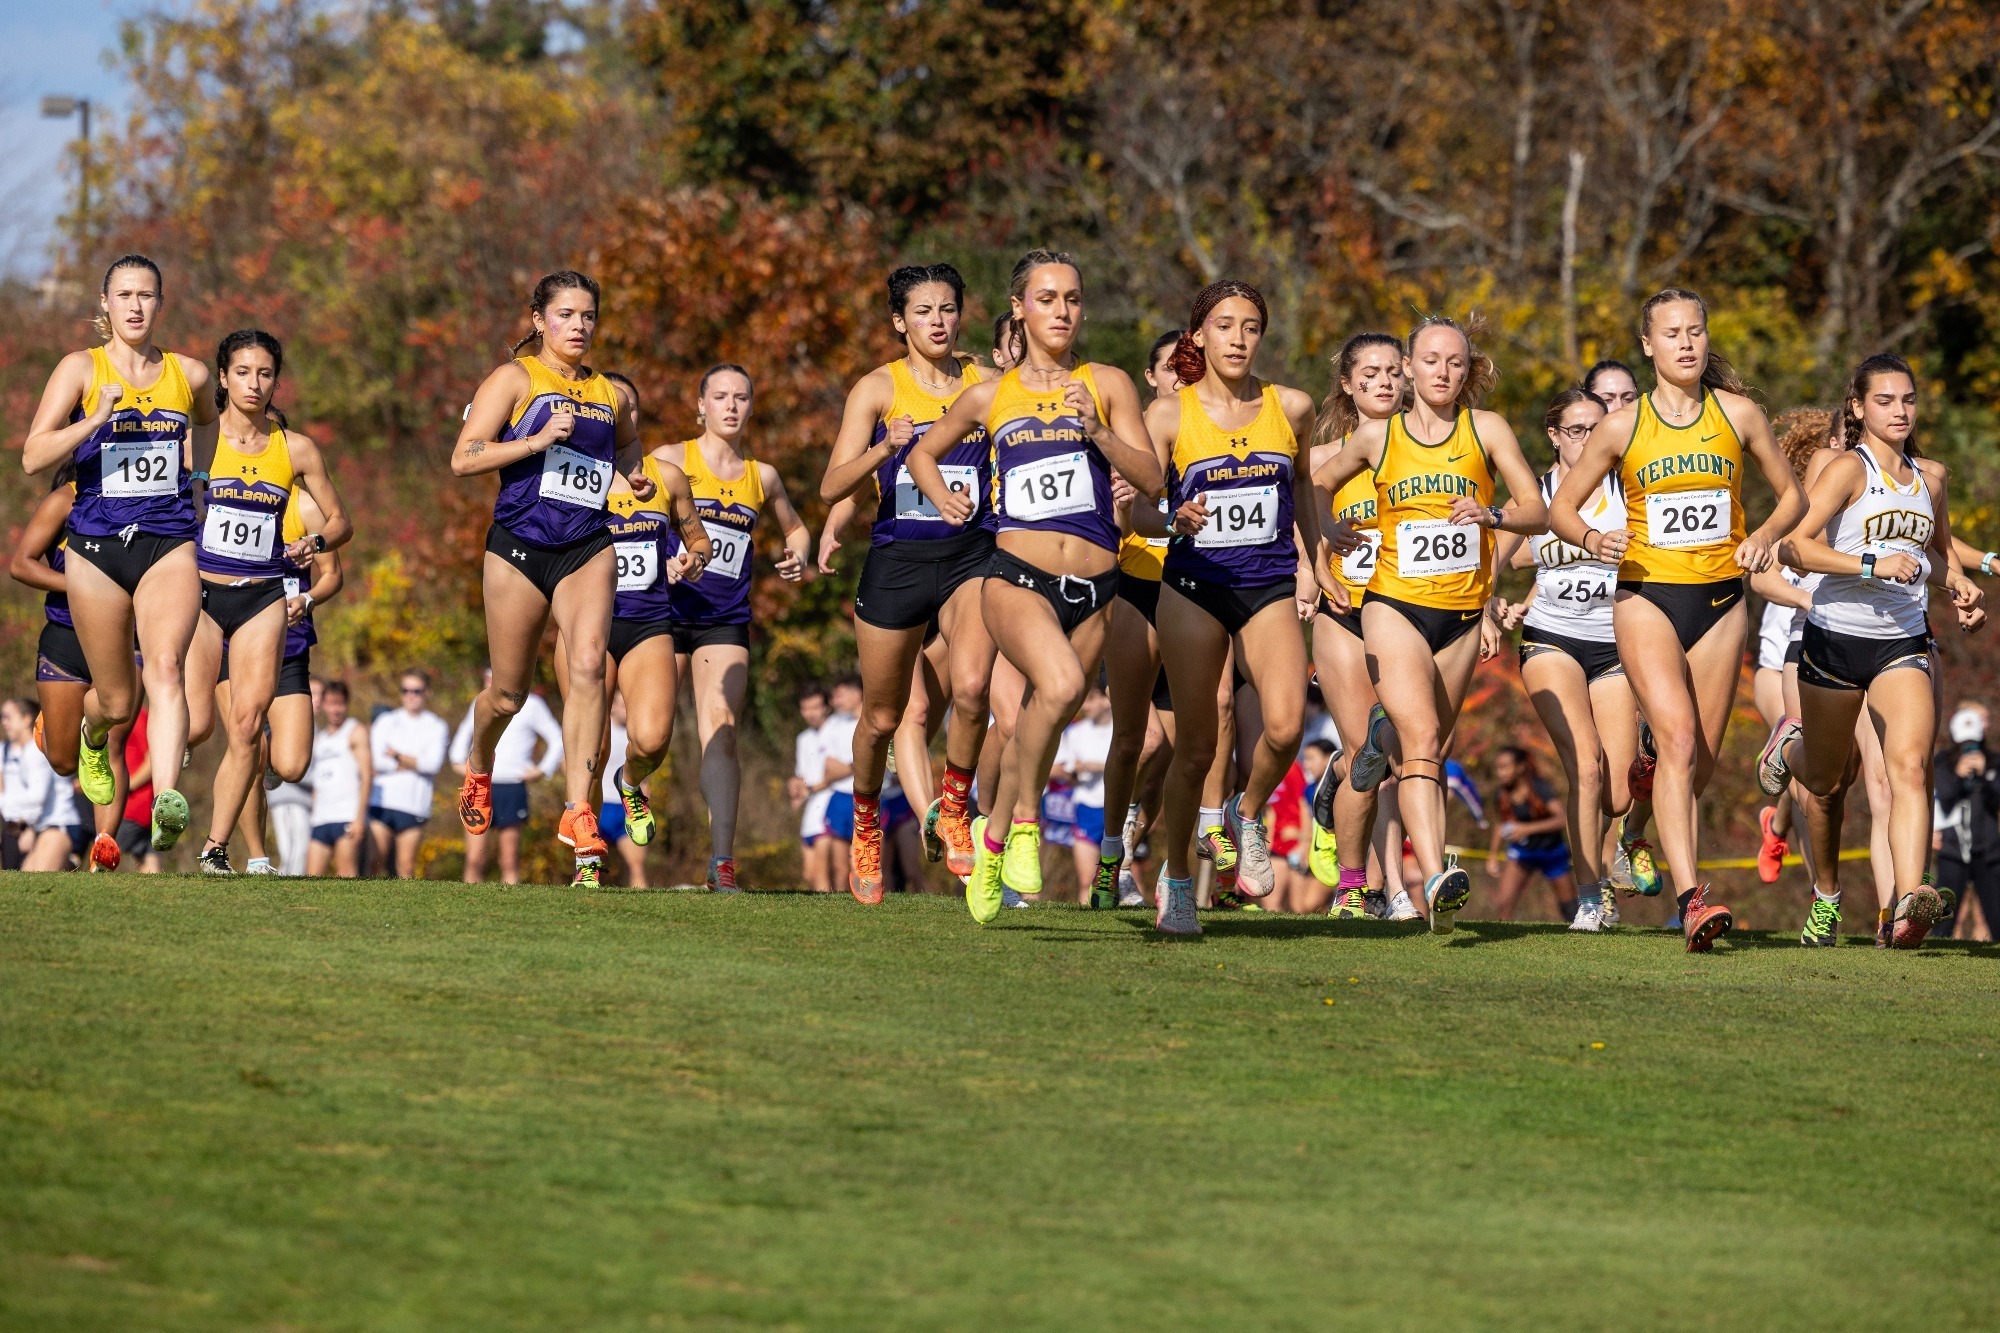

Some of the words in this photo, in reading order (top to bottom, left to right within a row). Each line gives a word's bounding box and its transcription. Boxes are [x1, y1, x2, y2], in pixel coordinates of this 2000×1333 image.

[550, 401, 614, 425] UALBANY
[113, 421, 179, 432] UALBANY
[118, 456, 168, 482] 192
[558, 462, 602, 494] 189
[1207, 464, 1278, 481] UALBANY
[1636, 453, 1735, 489] VERMONT
[213, 488, 281, 505] UALBANY
[1021, 469, 1075, 504] 187
[1387, 474, 1478, 508] VERMONT
[608, 521, 659, 534] ALBANY
[1211, 502, 1266, 532] 194
[1663, 504, 1718, 533] 262
[219, 520, 262, 547] 191
[712, 538, 735, 563] 90
[1413, 533, 1467, 562] 268
[1540, 538, 1599, 569] UM
[617, 555, 646, 577] 93
[1558, 579, 1608, 603] 254
